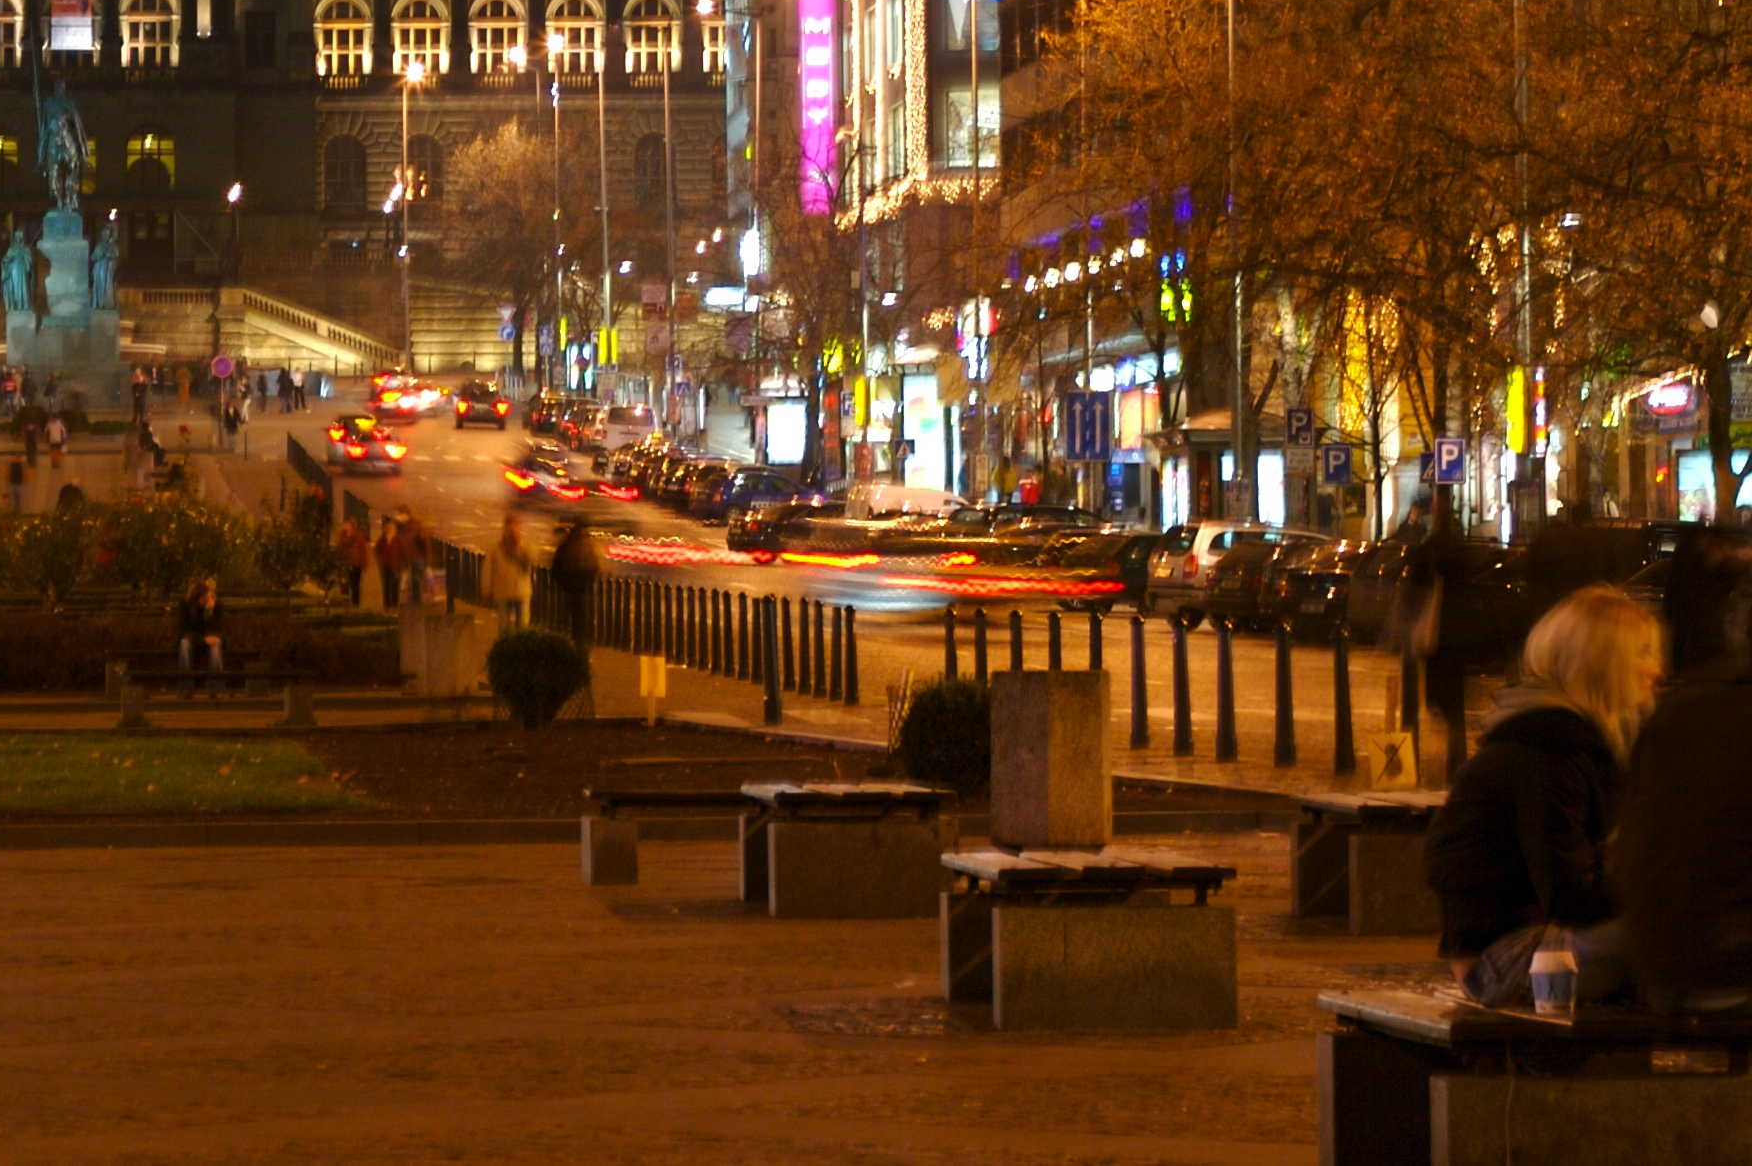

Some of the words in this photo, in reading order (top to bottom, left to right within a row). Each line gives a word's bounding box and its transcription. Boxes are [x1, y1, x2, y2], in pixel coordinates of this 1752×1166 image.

[1292, 412, 1308, 435] P
[1329, 450, 1346, 473] P
[1441, 443, 1459, 470] P
